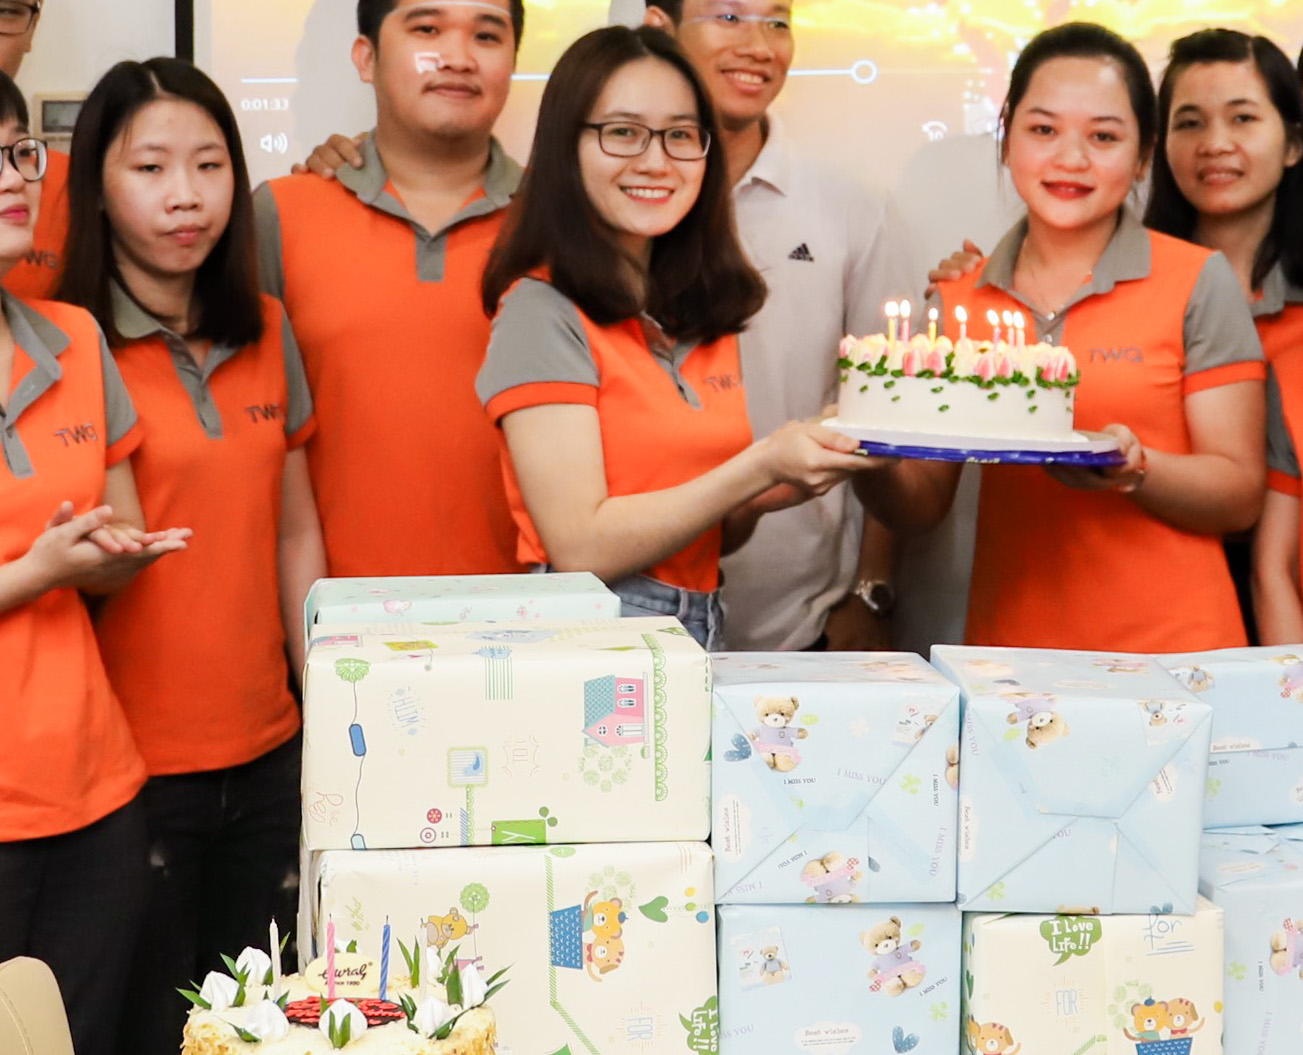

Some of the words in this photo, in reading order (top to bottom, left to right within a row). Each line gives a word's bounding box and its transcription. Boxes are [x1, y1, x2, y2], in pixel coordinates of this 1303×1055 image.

[241, 98, 290, 112] 0:01:33
[1088, 346, 1143, 364] TWG
[843, 770, 864, 782] MISS
[866, 773, 886, 786] YOU
[1054, 829, 1071, 840] OU
[935, 832, 946, 855] MISS
[929, 858, 940, 877] YOU
[1049, 919, 1061, 936] I
[935, 977, 948, 987] YOU
[1056, 989, 1078, 1017] FOR
[627, 1017, 653, 1041] FOR
[805, 1029, 821, 1037] Best
[824, 1027, 849, 1035] wishes
